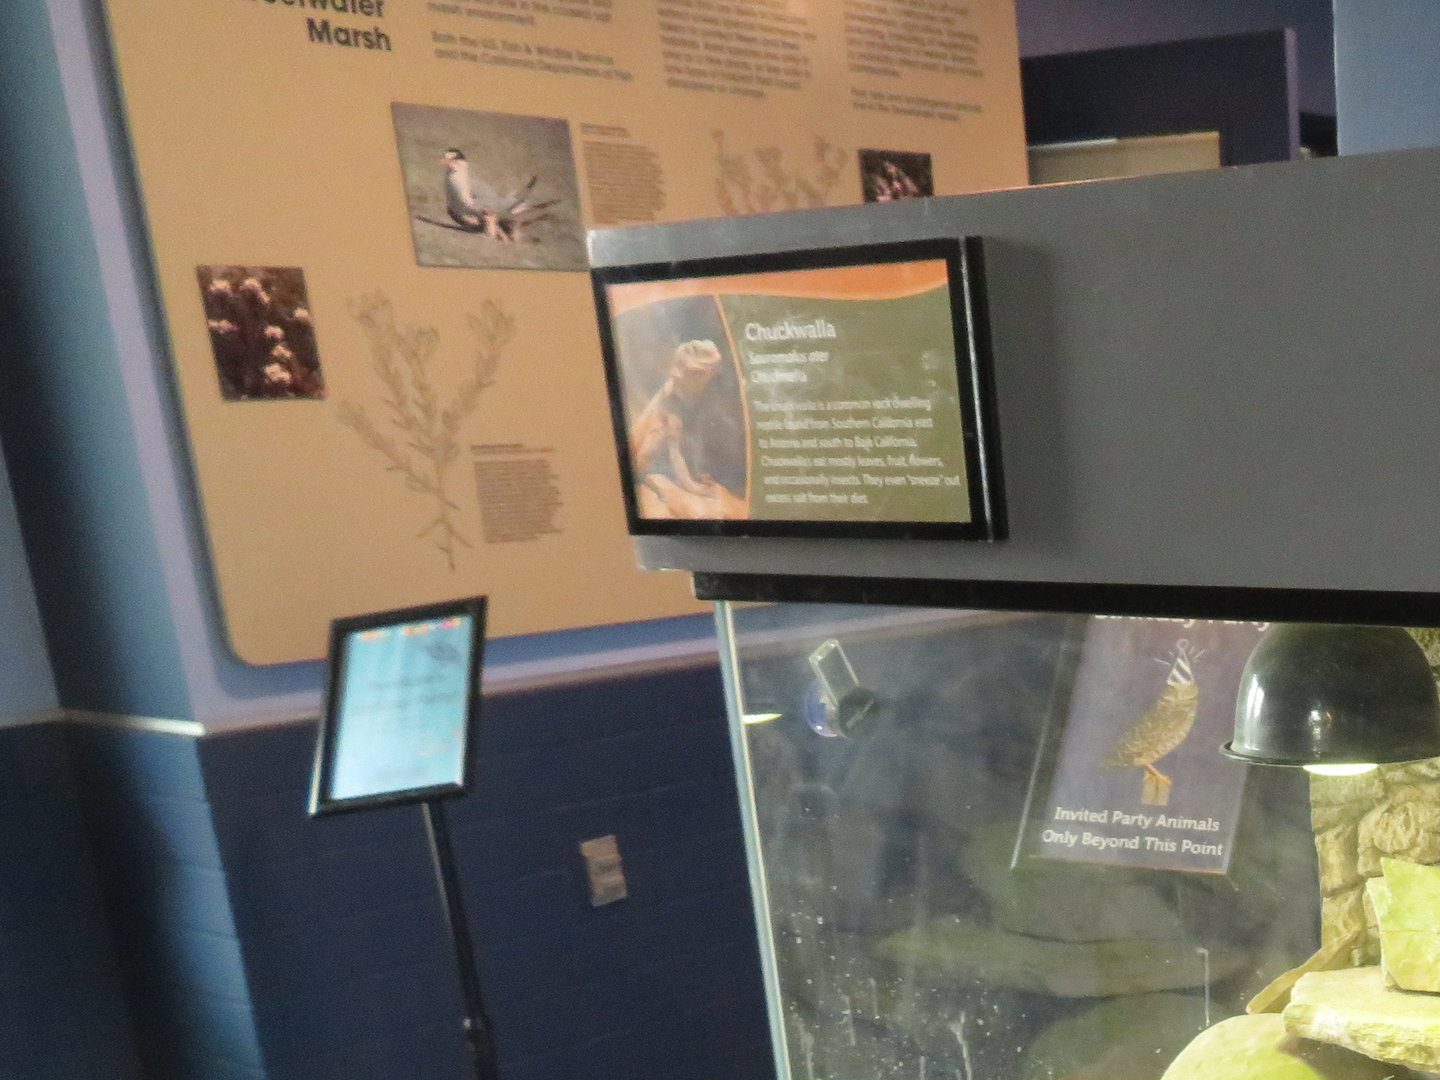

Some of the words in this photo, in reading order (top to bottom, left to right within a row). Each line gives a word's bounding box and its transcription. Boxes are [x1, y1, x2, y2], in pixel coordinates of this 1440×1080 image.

[306, 16, 392, 51] Marsh
[745, 319, 837, 341] Chuckwalla
[1055, 806, 1108, 824] Invited
[1111, 810, 1153, 830] Party
[1155, 814, 1220, 832] Animals
[1042, 829, 1078, 848] Only
[1081, 832, 1140, 850] Beyond
[1144, 836, 1177, 853] This
[1181, 839, 1224, 857] Point
